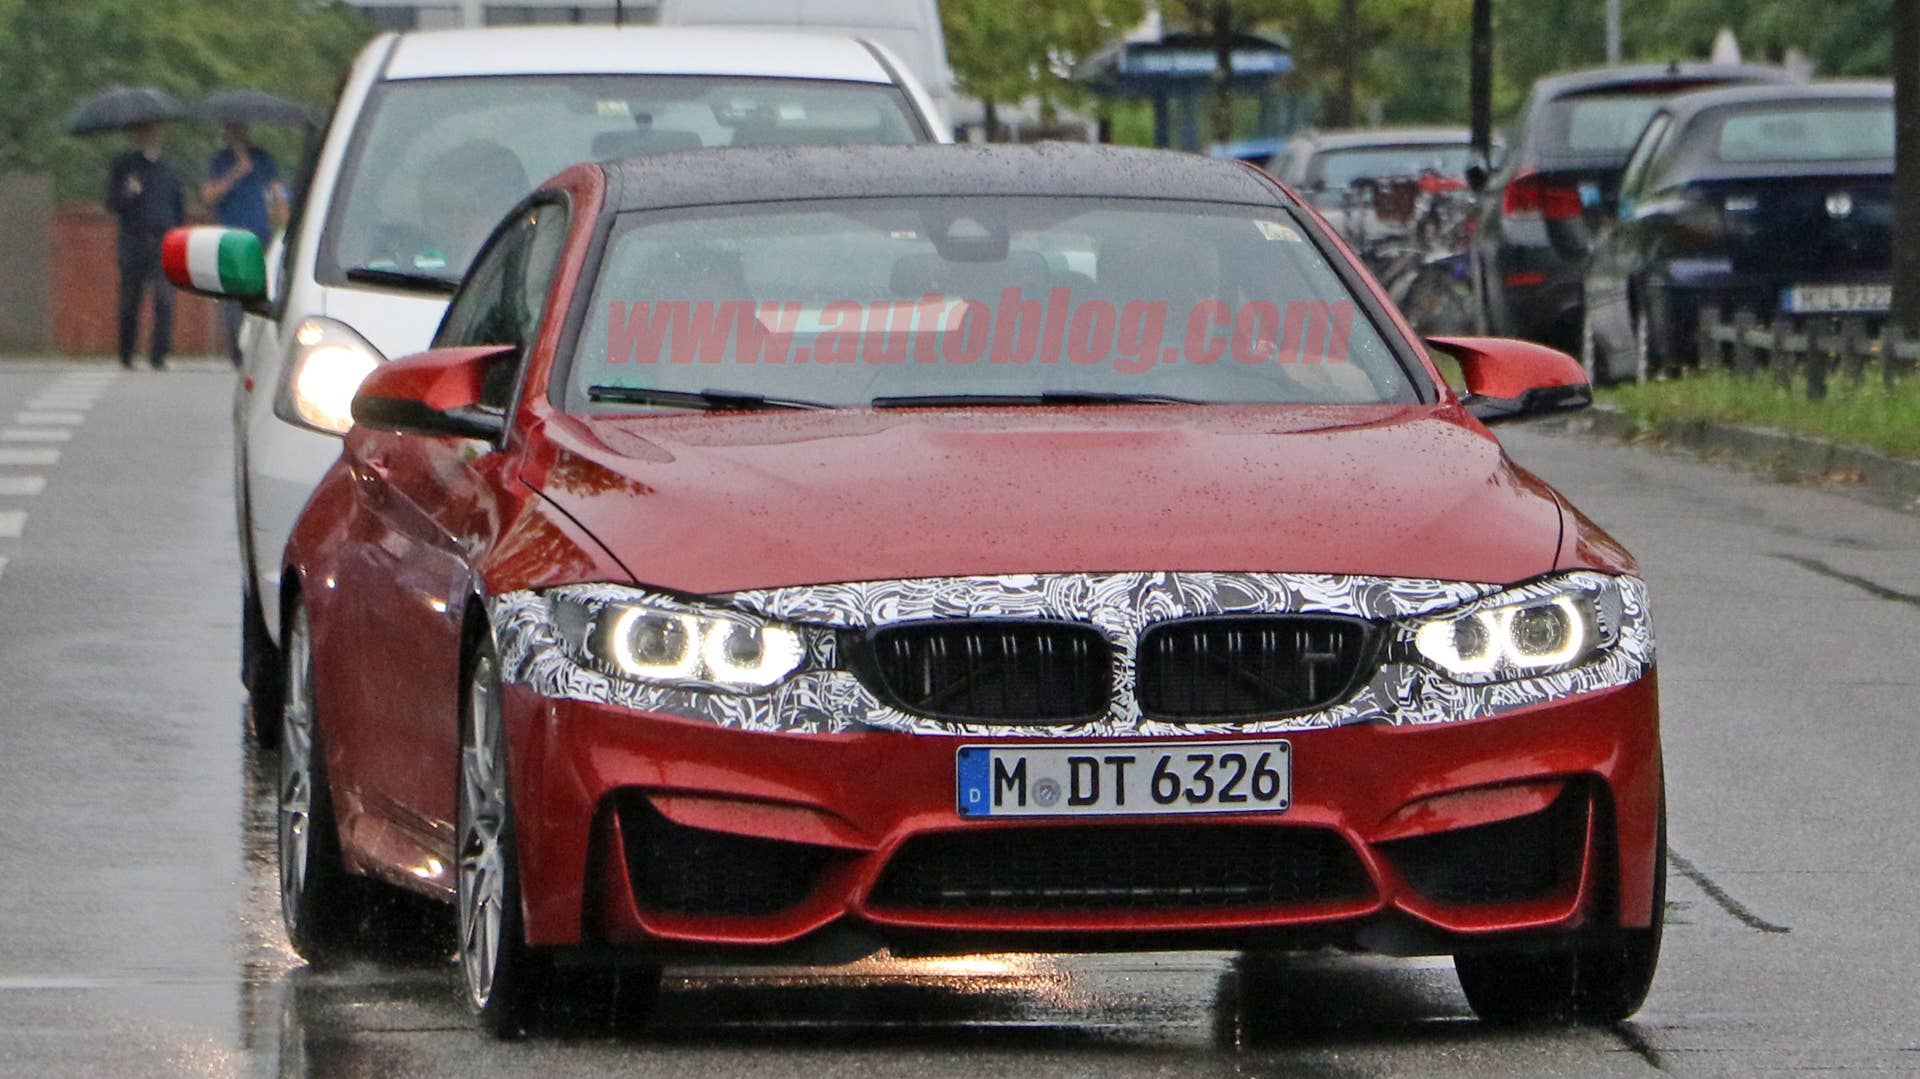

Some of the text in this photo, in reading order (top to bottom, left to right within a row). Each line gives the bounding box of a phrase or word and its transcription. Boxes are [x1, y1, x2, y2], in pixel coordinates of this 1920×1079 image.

[969, 752, 1281, 807] D M DT 6326
